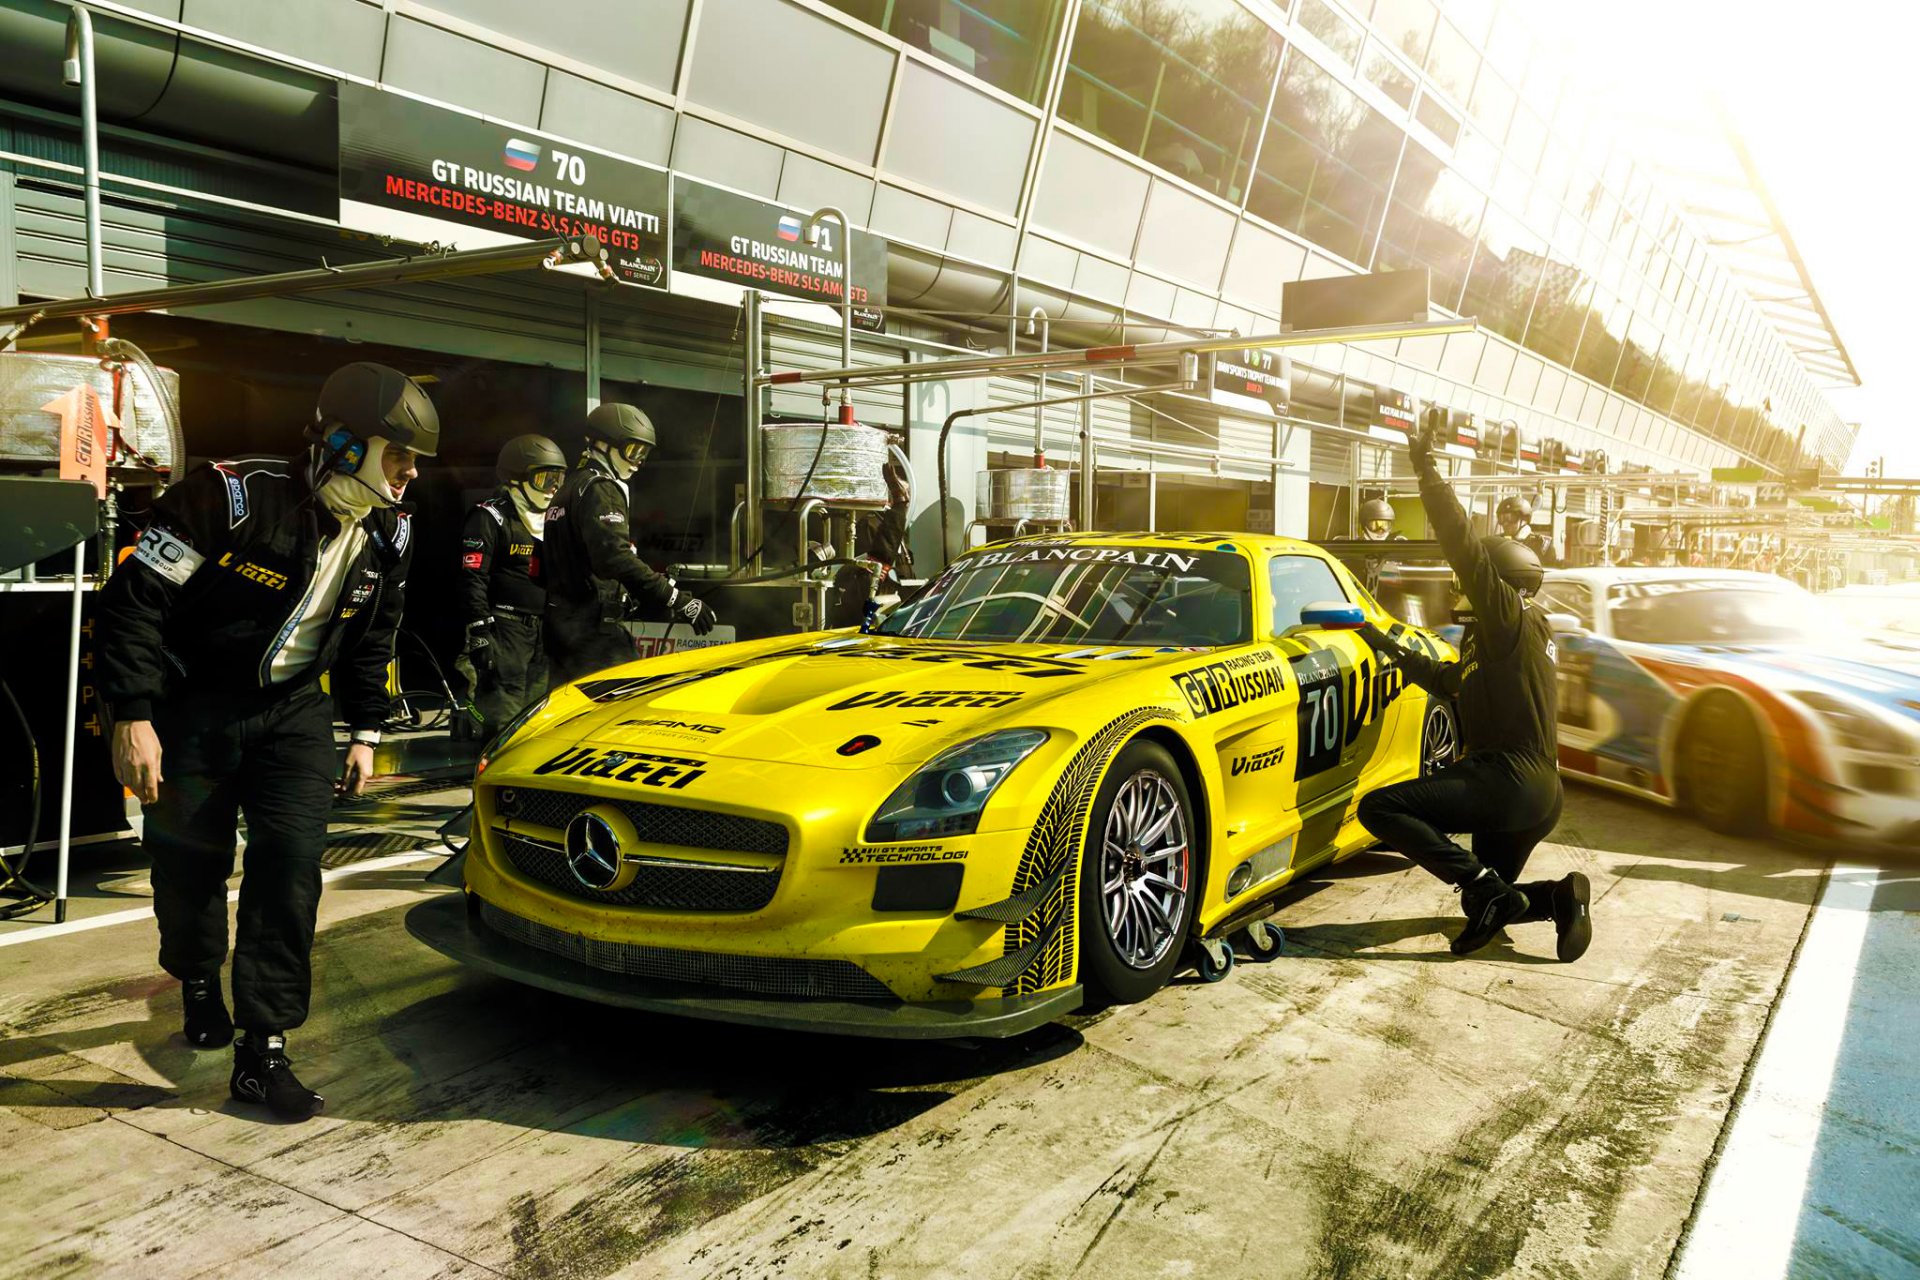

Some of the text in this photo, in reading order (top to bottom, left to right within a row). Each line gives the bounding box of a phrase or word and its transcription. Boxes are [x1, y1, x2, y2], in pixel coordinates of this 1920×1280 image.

[551, 150, 586, 186] 70
[432, 159, 659, 234] GT RUSSIAN TEAM VIATTI
[386, 175, 640, 252] MERCEDES-BENZ SLS AMG GT3
[620, 259, 656, 272] BLANCPAIN
[731, 236, 843, 279] GT RUSSIAN TEAM
[701, 250, 800, 287] MERCEDES-BENZ
[801, 275, 820, 293] SLS
[151, 556, 173, 572] GROUP
[973, 548, 1200, 572] BLANCPAIN
[677, 638, 707, 649] RACING
[1226, 650, 1275, 671] RACING TEAM
[1297, 663, 1340, 686] BLANCPAIN
[826, 690, 1023, 711] Viatti
[1306, 685, 1339, 757] 70
[533, 747, 707, 790] Viatti
[1231, 750, 1286, 777] Viatti
[866, 850, 969, 862] TECHNOLOGI
[898, 845, 943, 853] SPORTS
